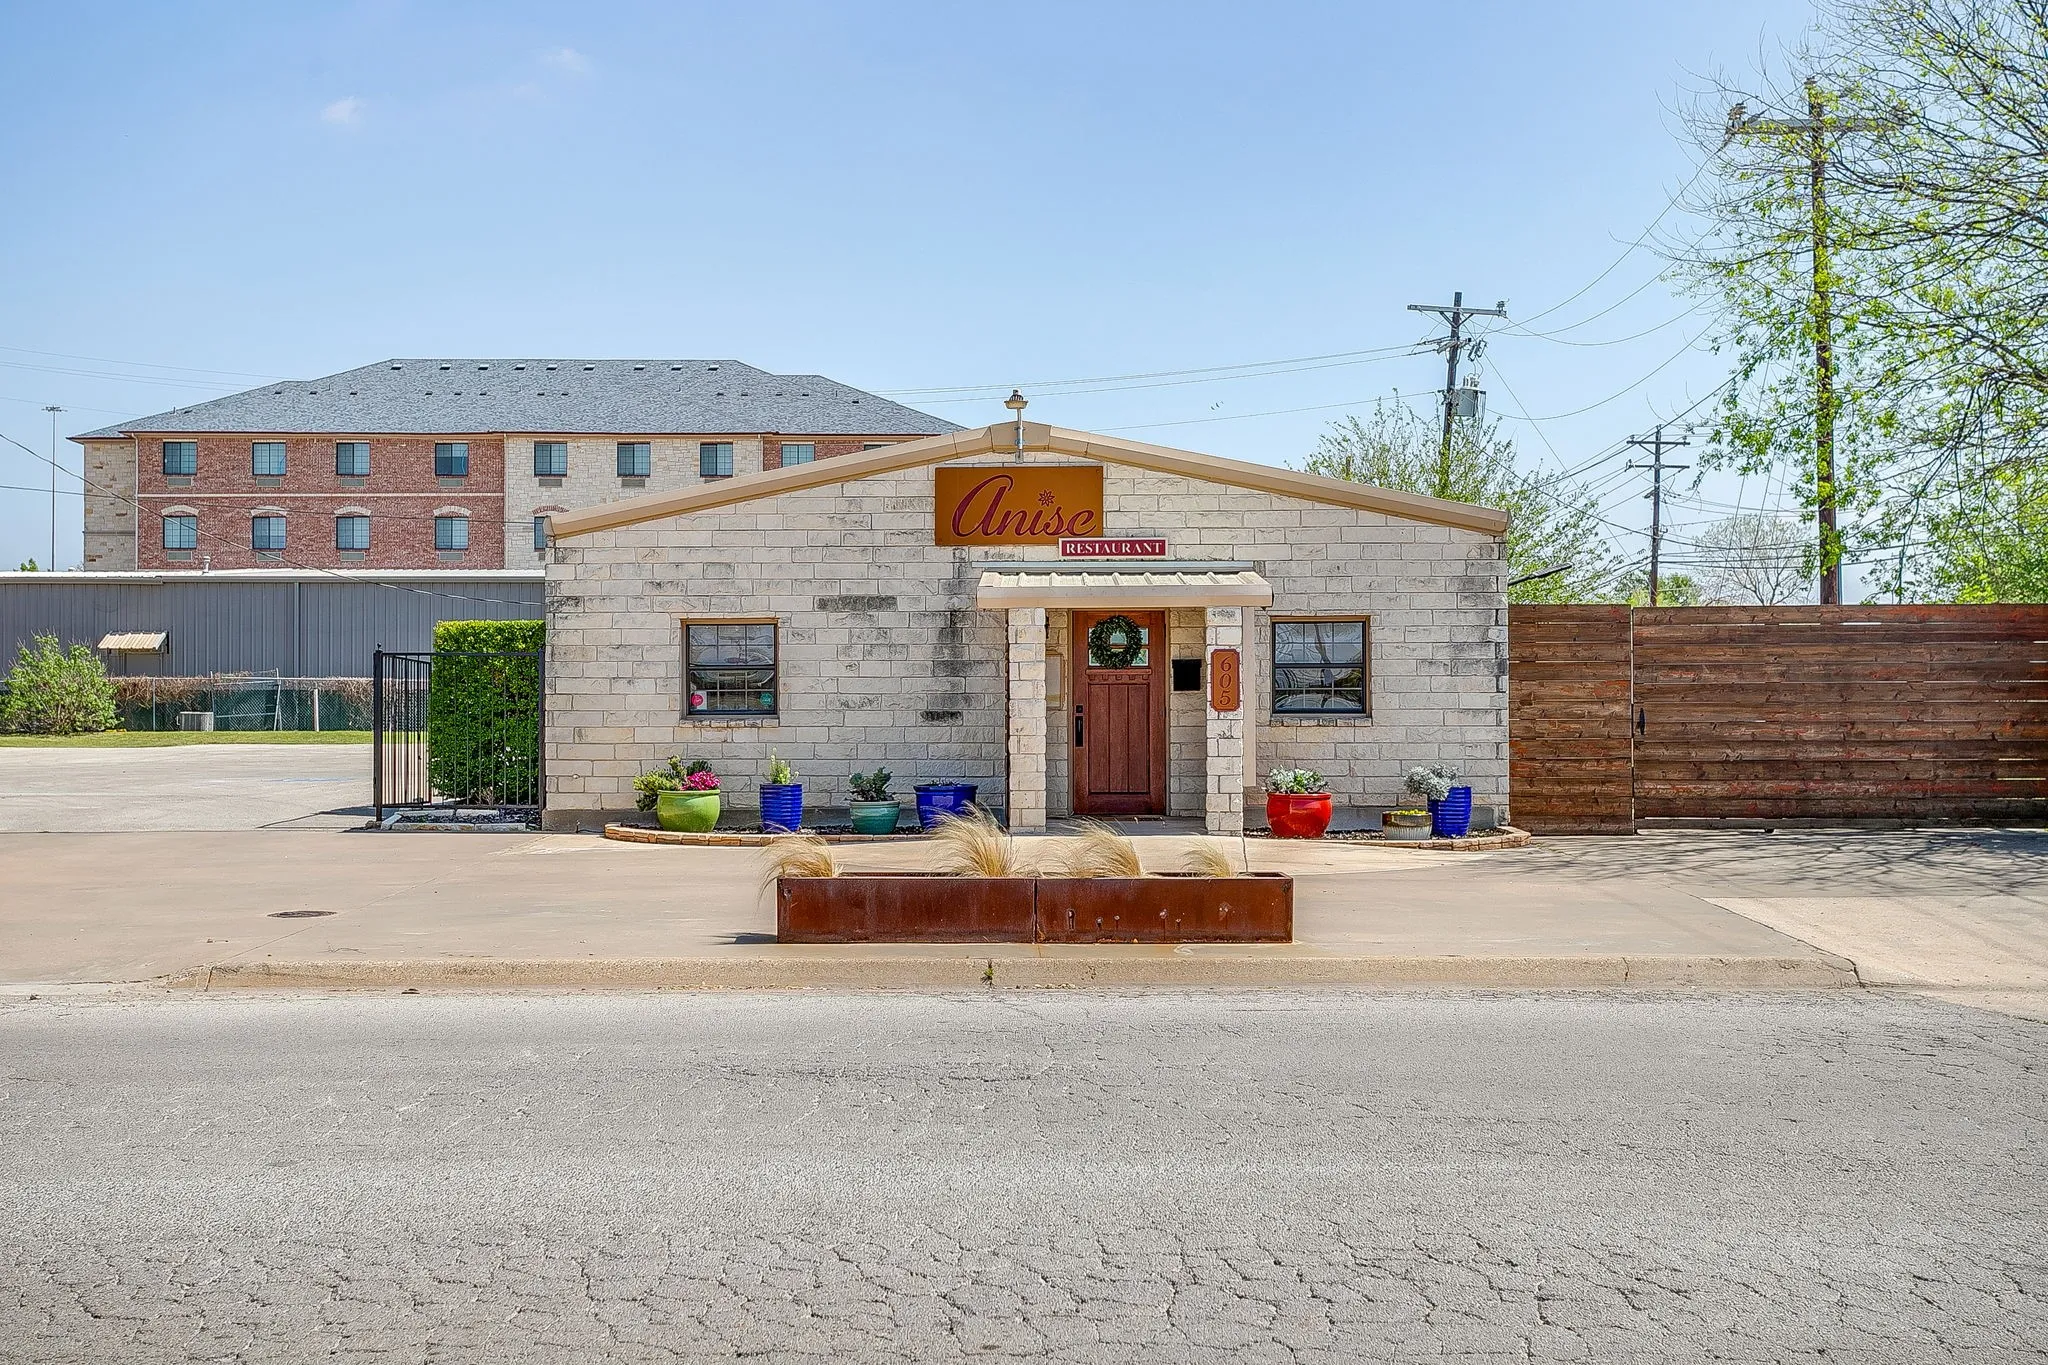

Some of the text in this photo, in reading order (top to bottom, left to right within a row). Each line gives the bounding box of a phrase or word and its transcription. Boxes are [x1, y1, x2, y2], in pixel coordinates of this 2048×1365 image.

[952, 474, 1097, 536] Anise
[1065, 541, 1163, 555] RESTAURANT
[1219, 656, 1232, 706] 605
